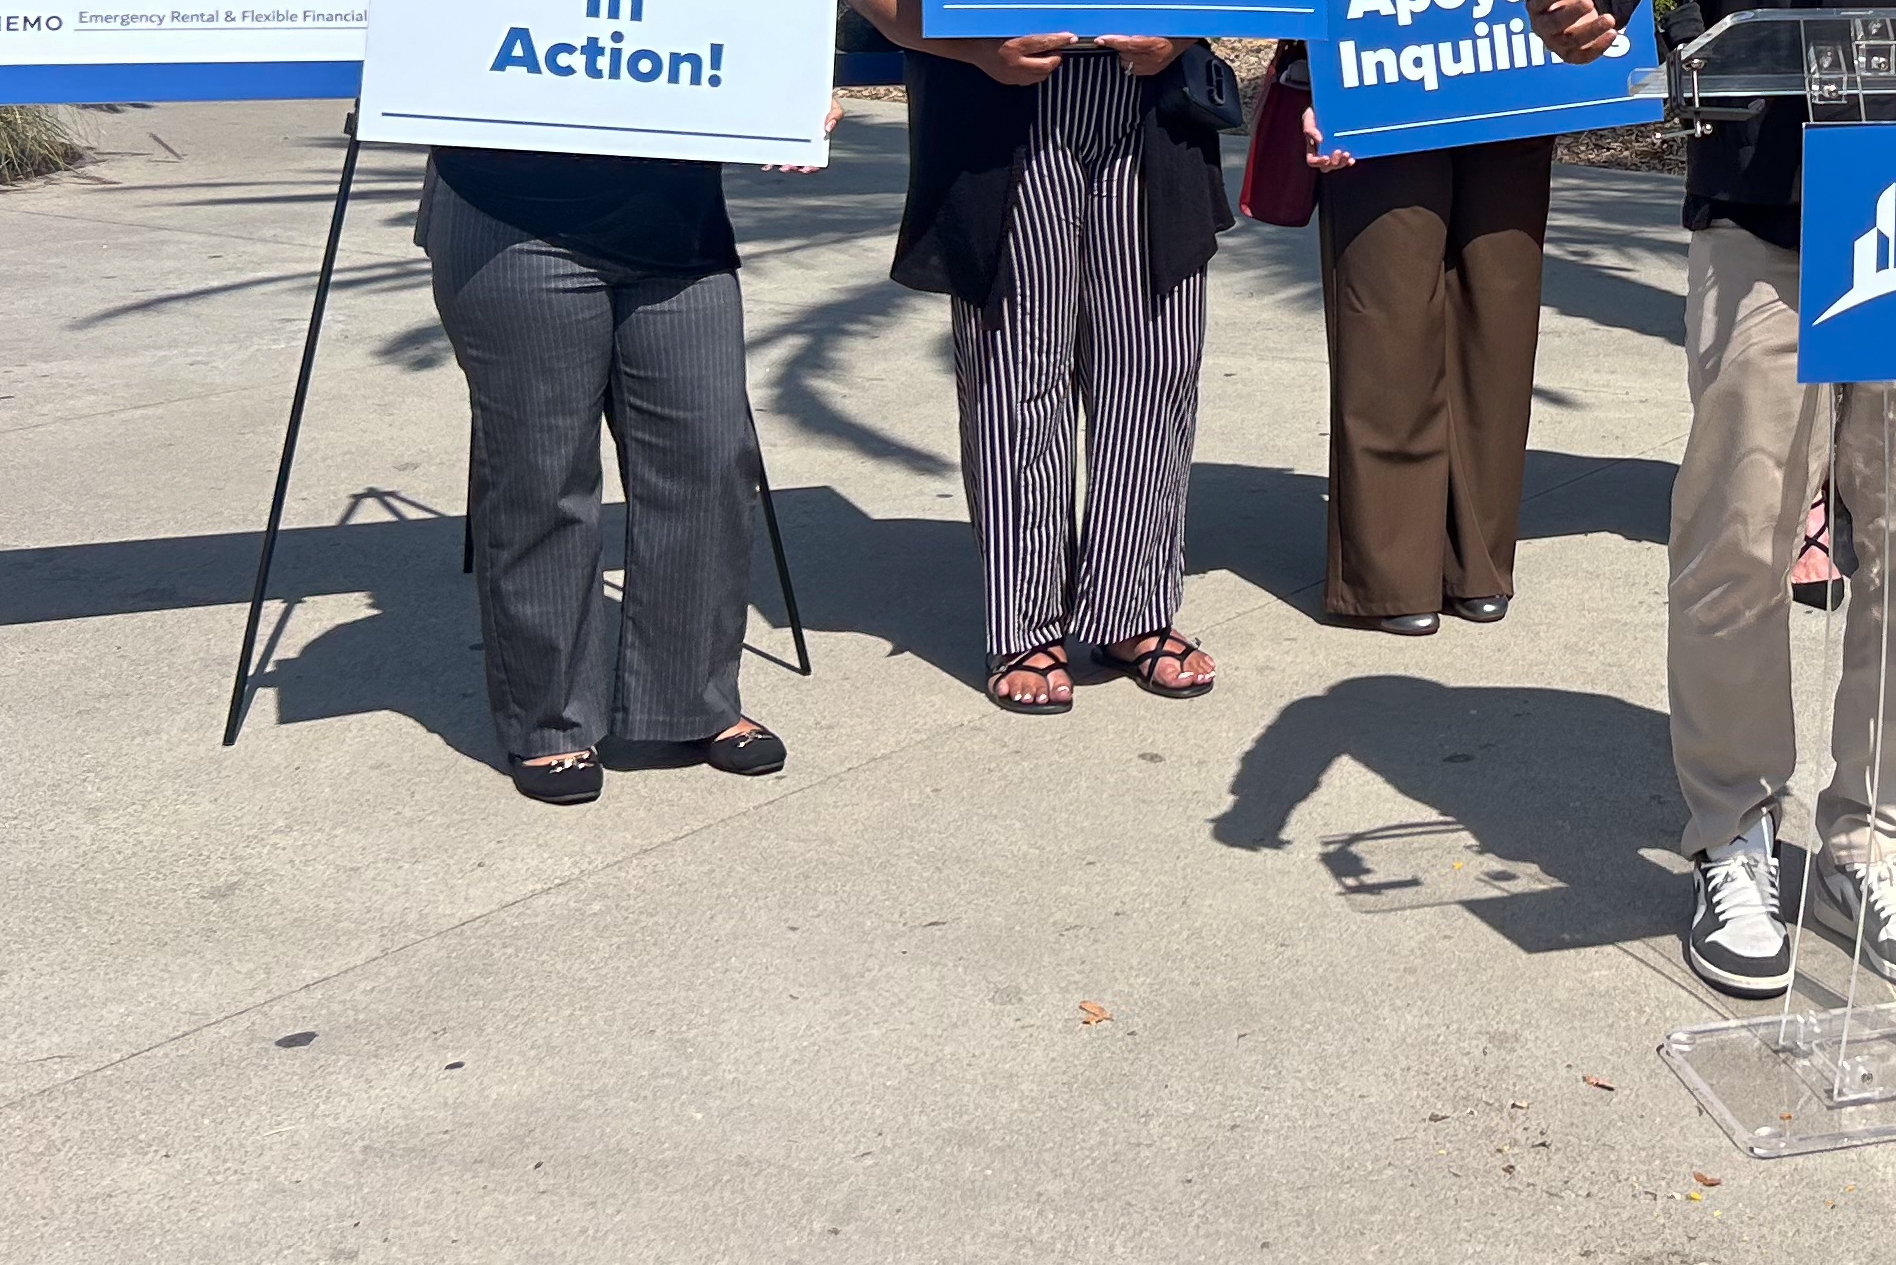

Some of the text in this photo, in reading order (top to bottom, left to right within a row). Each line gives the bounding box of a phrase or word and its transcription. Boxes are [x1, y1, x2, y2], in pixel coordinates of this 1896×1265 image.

[0, 9, 368, 32] EMO Emergency Rental & Flexible Financial
[489, 26, 724, 88] Action!
[1338, 16, 1631, 92] Inquilins
